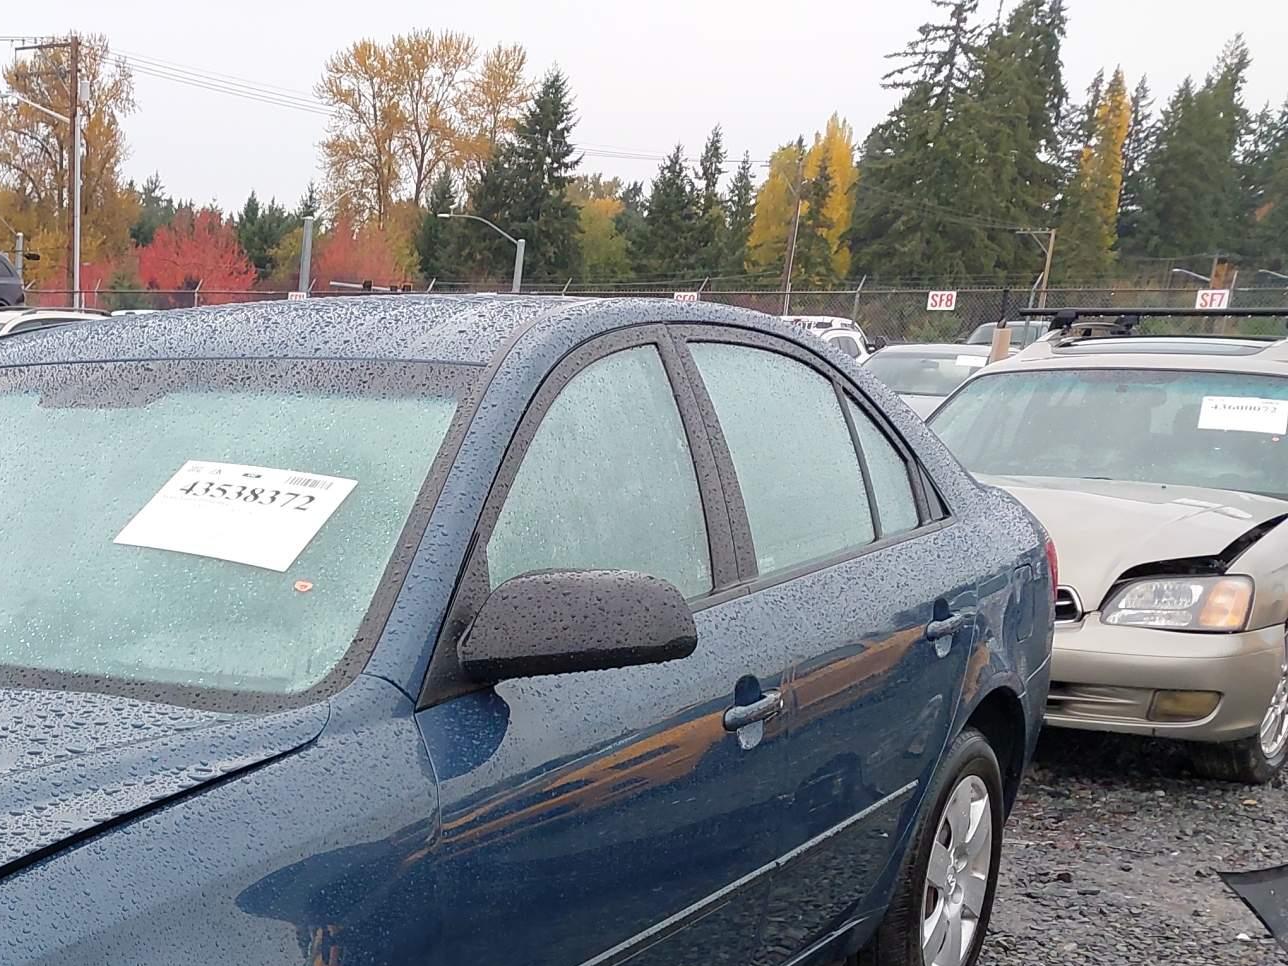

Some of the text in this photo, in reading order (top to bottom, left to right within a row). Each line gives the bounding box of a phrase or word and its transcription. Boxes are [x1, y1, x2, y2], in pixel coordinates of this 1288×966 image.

[930, 293, 954, 308] SF8
[1199, 292, 1225, 308] SF7
[179, 481, 315, 511] 43538372
